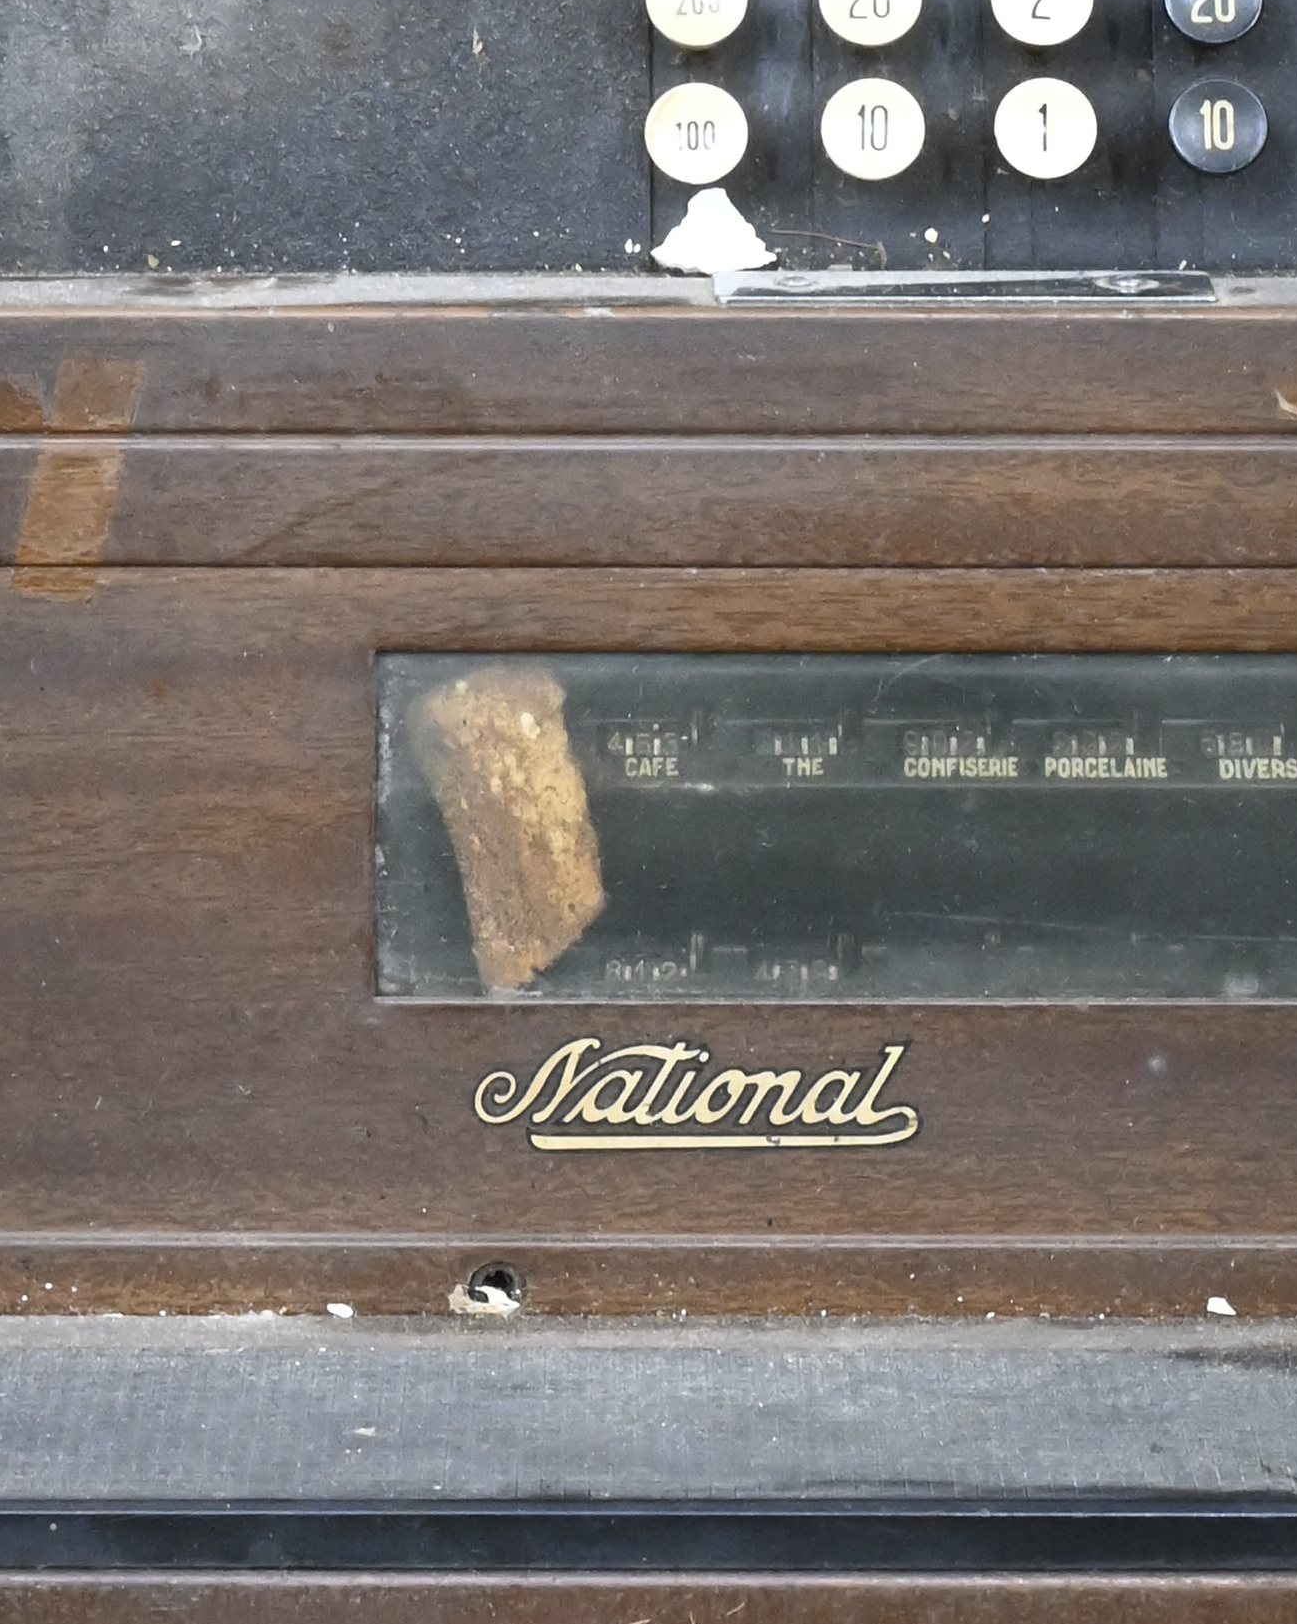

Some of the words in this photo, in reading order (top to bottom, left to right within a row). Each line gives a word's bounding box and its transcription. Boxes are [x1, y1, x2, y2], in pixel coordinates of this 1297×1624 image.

[677, 121, 715, 150] 100
[857, 109, 889, 151] 10
[1038, 104, 1048, 152] 1
[1200, 100, 1234, 148] 10
[625, 757, 679, 776] CAFE
[783, 757, 824, 776] THE
[904, 756, 1018, 777] CONFISERIE
[1045, 757, 1167, 777] PORCELAINE
[475, 1038, 918, 1150] National
